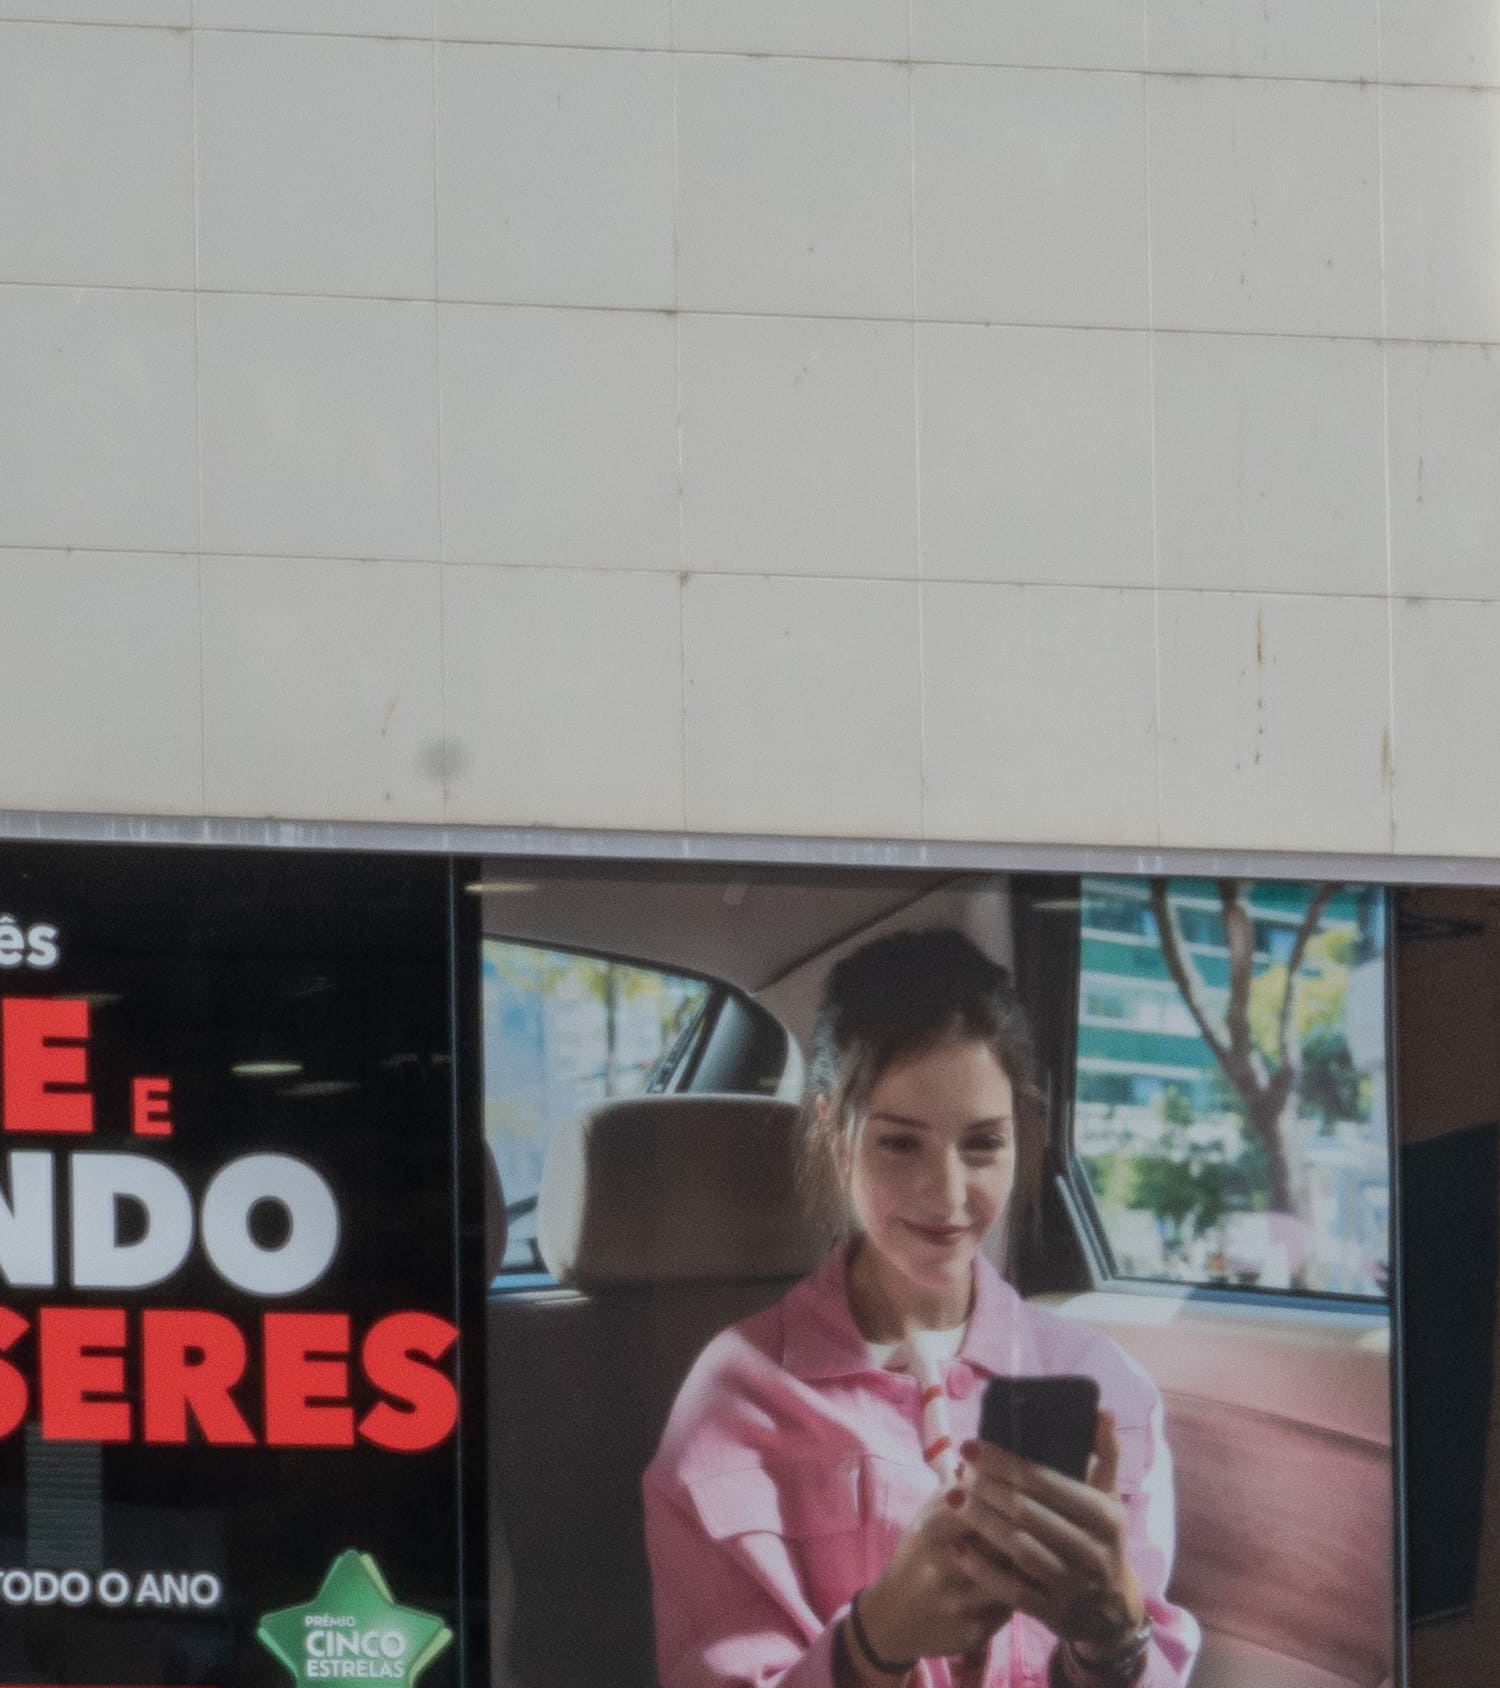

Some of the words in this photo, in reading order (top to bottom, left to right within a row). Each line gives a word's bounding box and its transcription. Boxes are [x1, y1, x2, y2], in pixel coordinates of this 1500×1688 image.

[132, 1077, 172, 1136] E
[99, 1571, 130, 1604] O
[136, 1573, 220, 1605] ANO
[304, 1614, 356, 1627] PRÉMIO
[305, 1631, 406, 1658] CINCO
[306, 1660, 405, 1678] ESTRELAS
